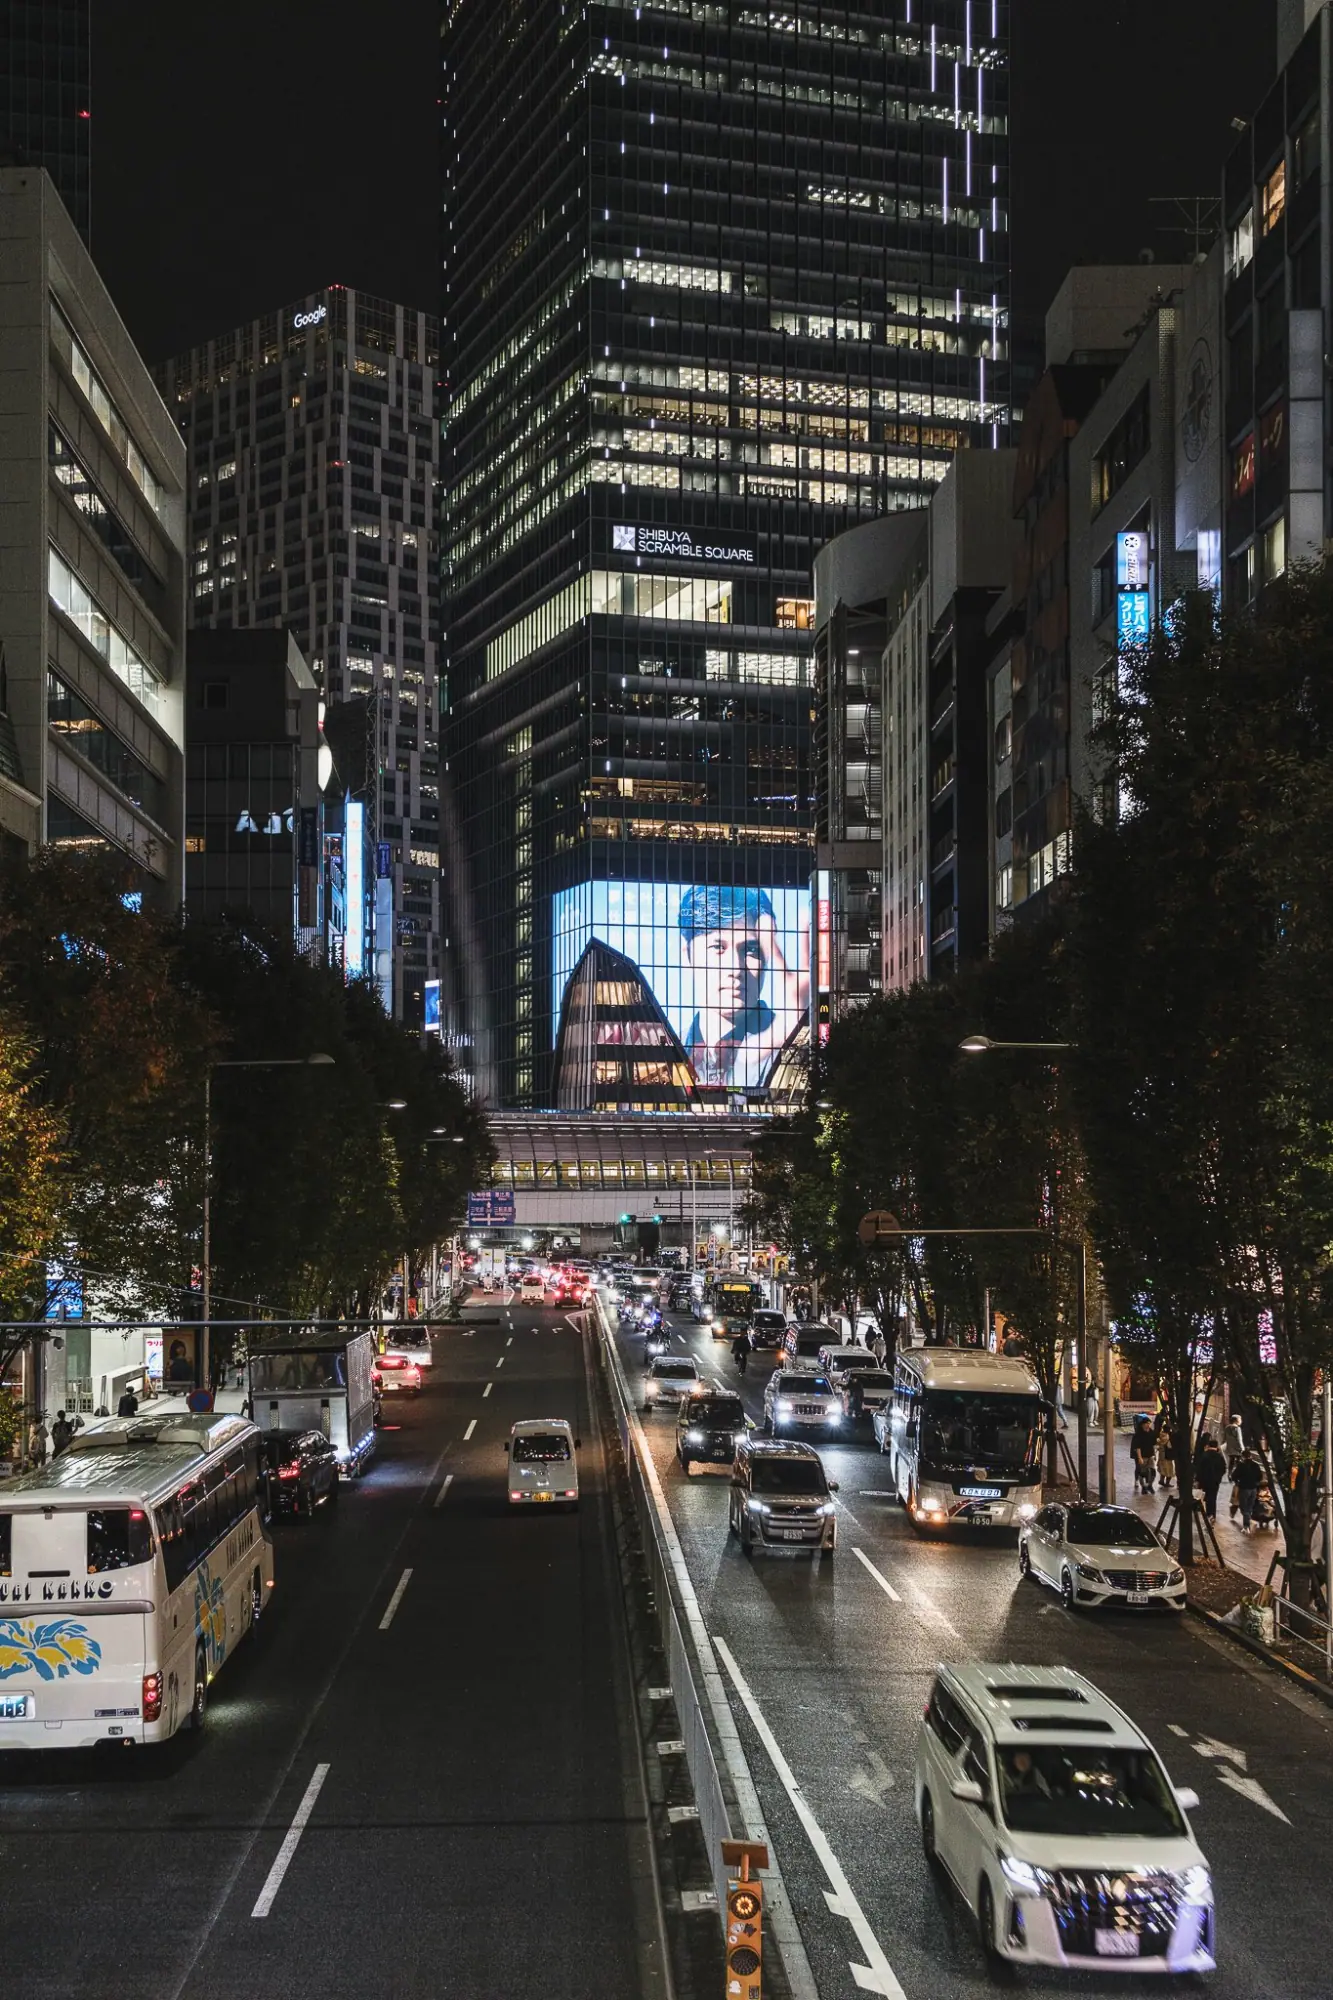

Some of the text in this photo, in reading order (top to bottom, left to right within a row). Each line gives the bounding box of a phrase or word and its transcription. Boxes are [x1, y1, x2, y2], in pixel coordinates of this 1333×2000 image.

[294, 305, 326, 328] Google
[638, 528, 692, 544] SHIBUYA
[638, 541, 754, 562] SCRAMBLE SQUARE
[43, 1579, 114, 1600] KANKO
